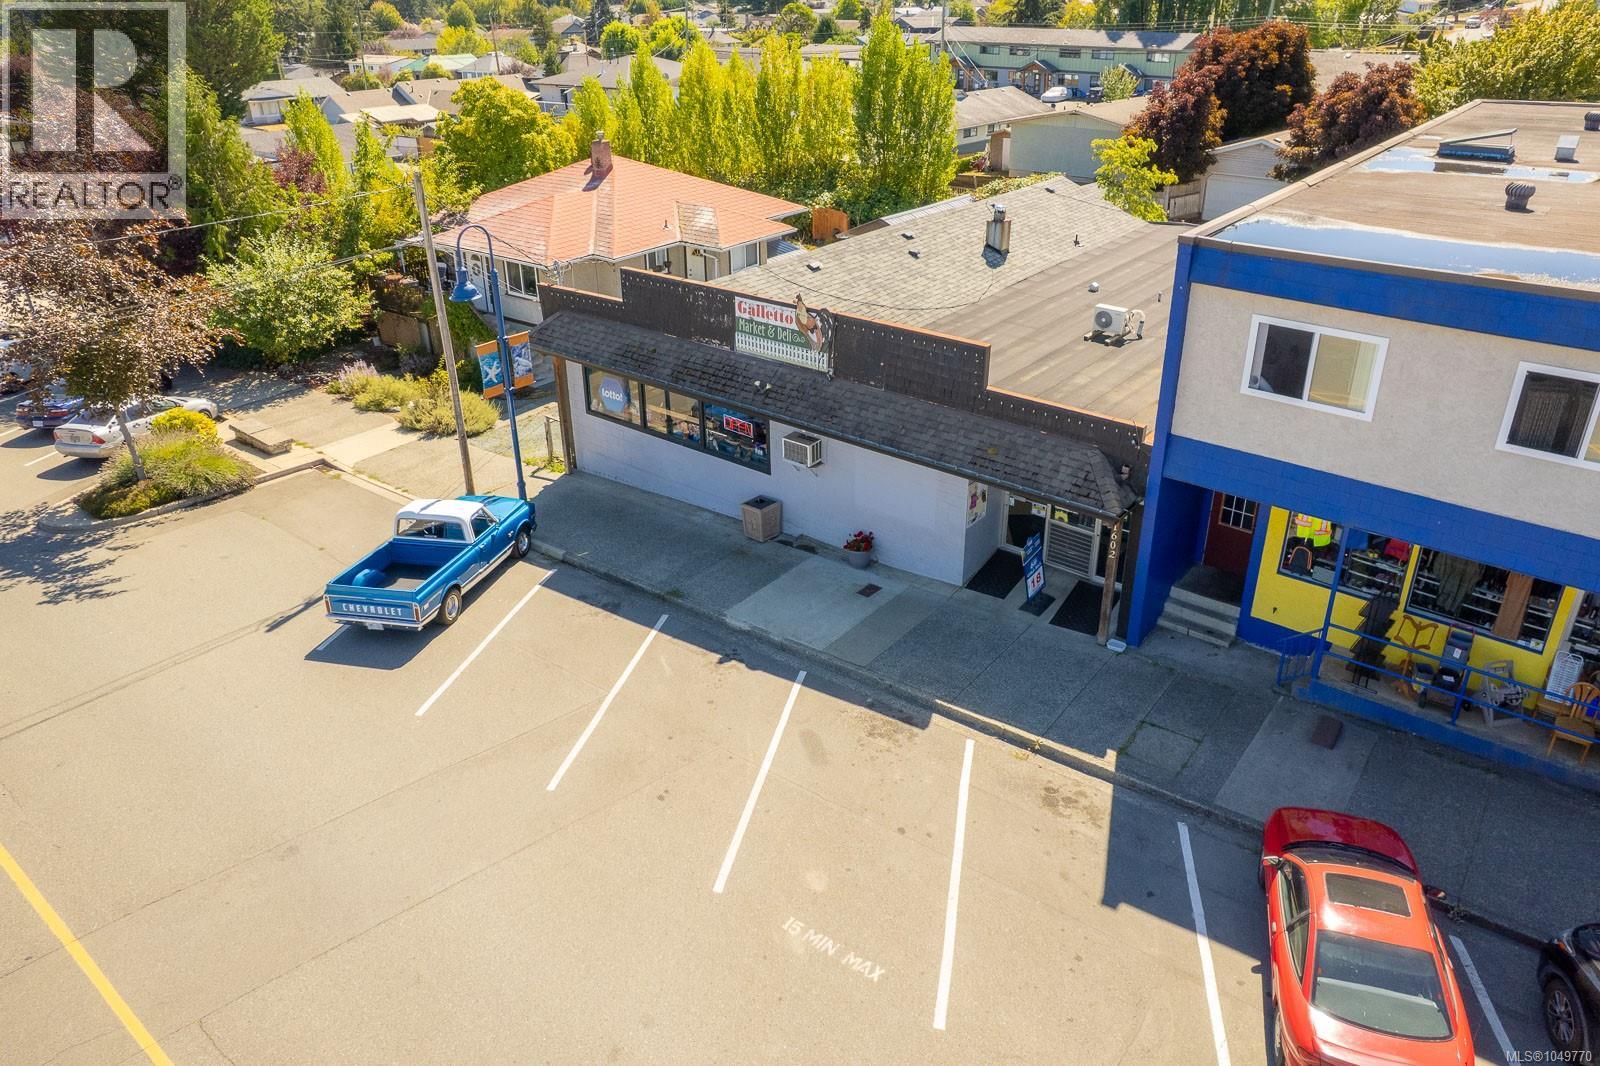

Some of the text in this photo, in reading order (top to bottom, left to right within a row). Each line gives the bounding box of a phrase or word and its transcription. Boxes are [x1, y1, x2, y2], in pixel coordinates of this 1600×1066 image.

[737, 300, 794, 325] Galletto
[739, 318, 792, 343] Market & Deli
[725, 416, 752, 437] OPEN
[342, 602, 402, 616] CHEVROLET
[782, 916, 886, 982] 15 MIN MAX
